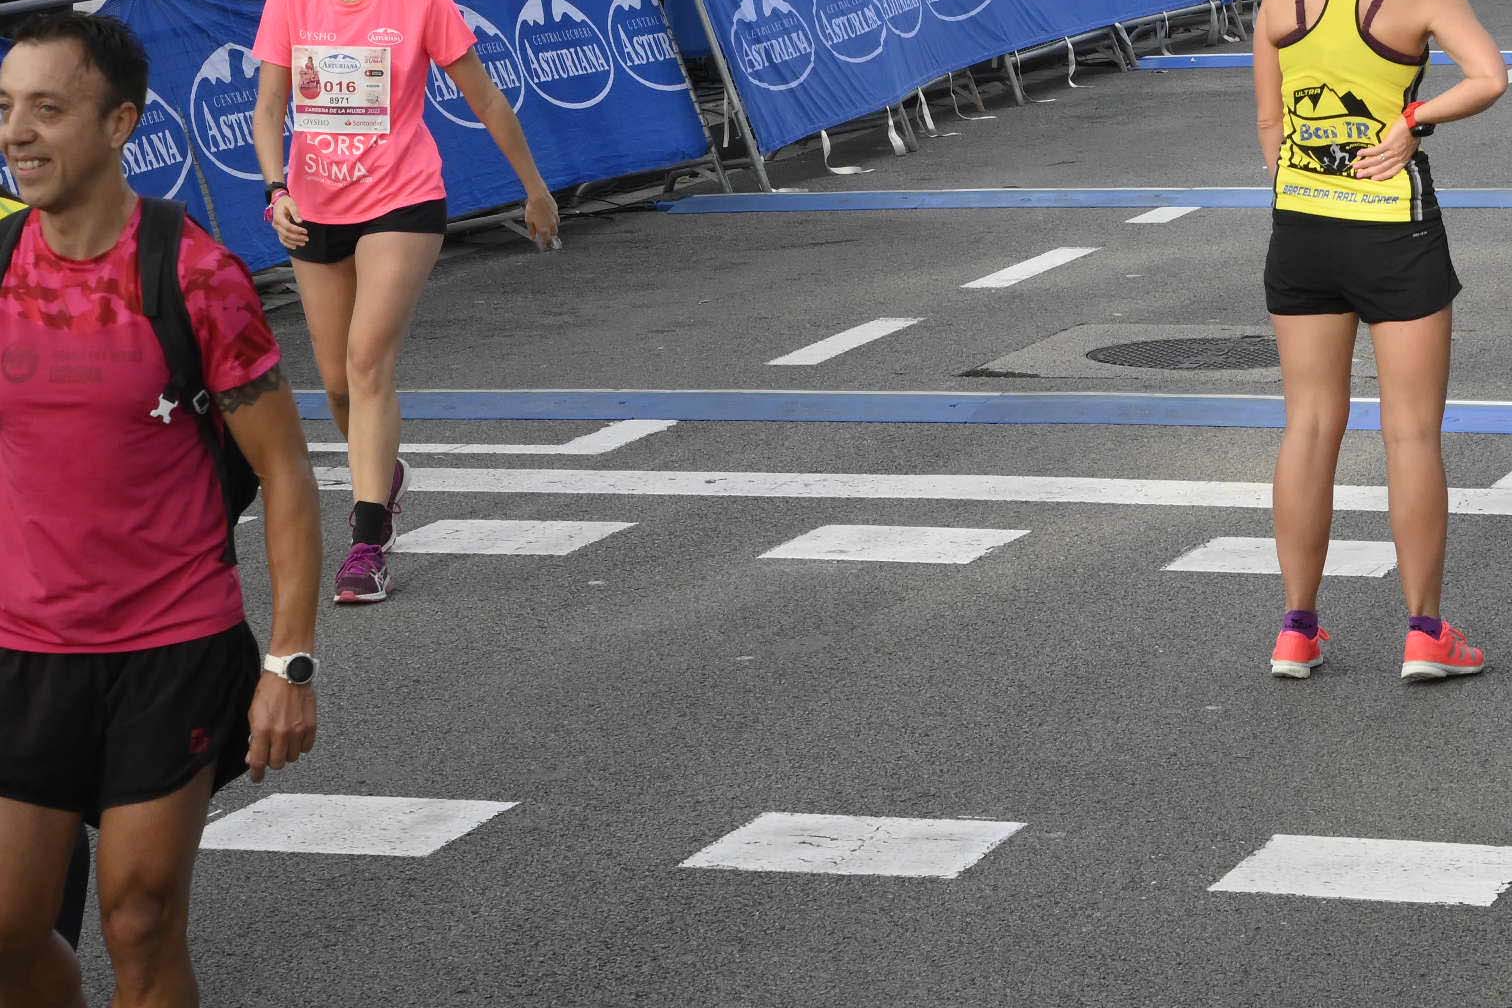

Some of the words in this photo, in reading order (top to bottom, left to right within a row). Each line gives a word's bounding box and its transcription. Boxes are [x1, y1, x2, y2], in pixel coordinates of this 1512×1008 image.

[300, 31, 336, 42] OYSHO
[532, 31, 562, 46] CENTRAL
[562, 26, 593, 43] LECHERA
[322, 60, 359, 70] ASTURIANA
[524, 39, 609, 84] ASTURIANA
[324, 80, 357, 93] 016
[1295, 88, 1321, 98] ULTRA
[329, 96, 350, 105] 8971
[304, 153, 368, 182] SUMA
[1283, 184, 1329, 198] BARCELONA
[1332, 190, 1357, 203] TRAIL
